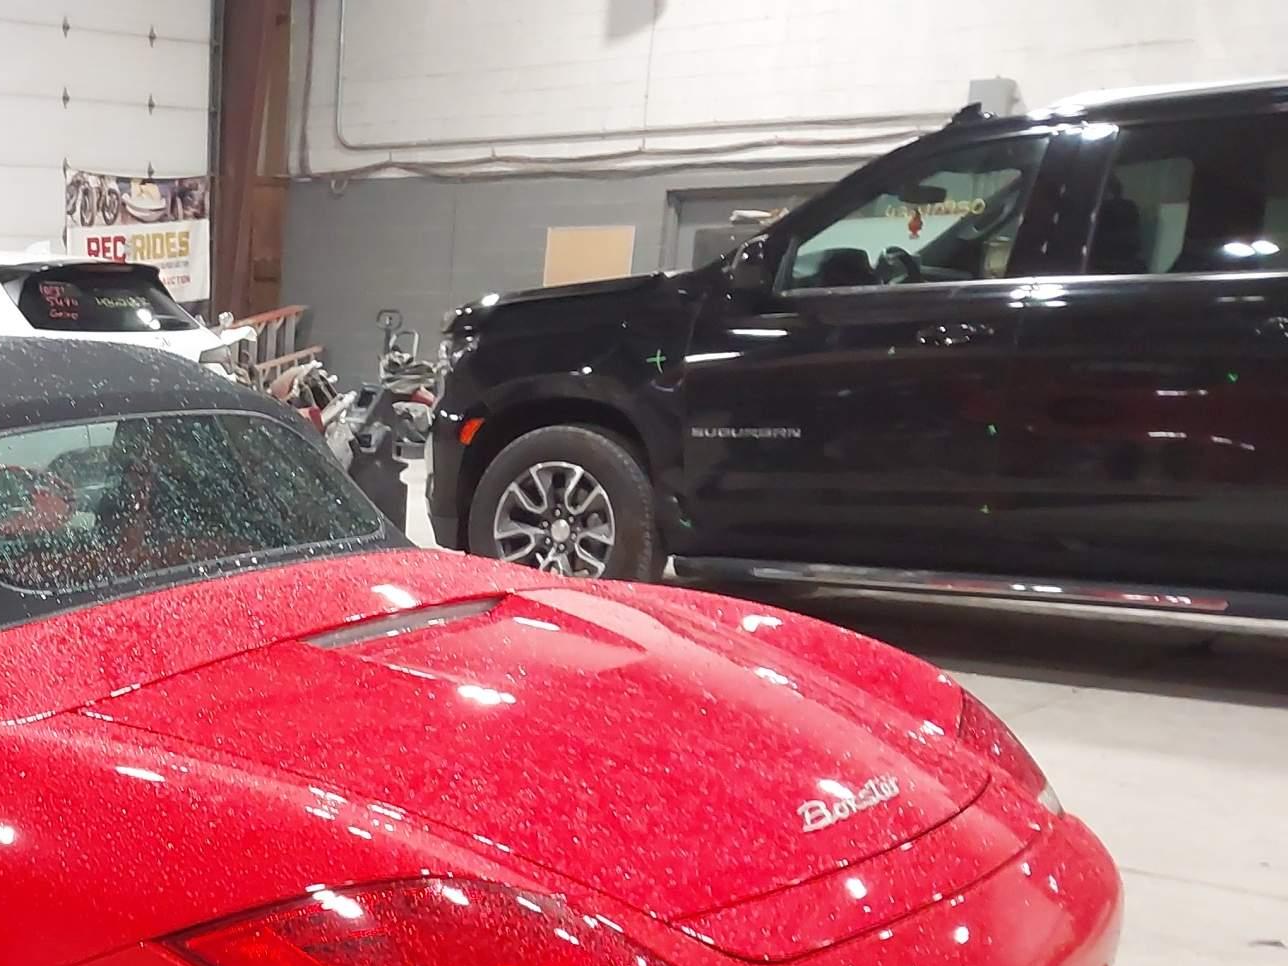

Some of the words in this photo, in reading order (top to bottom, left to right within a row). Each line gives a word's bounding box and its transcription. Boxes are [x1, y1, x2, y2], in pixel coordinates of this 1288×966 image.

[86, 235, 127, 263] REC
[132, 231, 190, 261] RIDES
[691, 427, 802, 439] SUBURBAN
